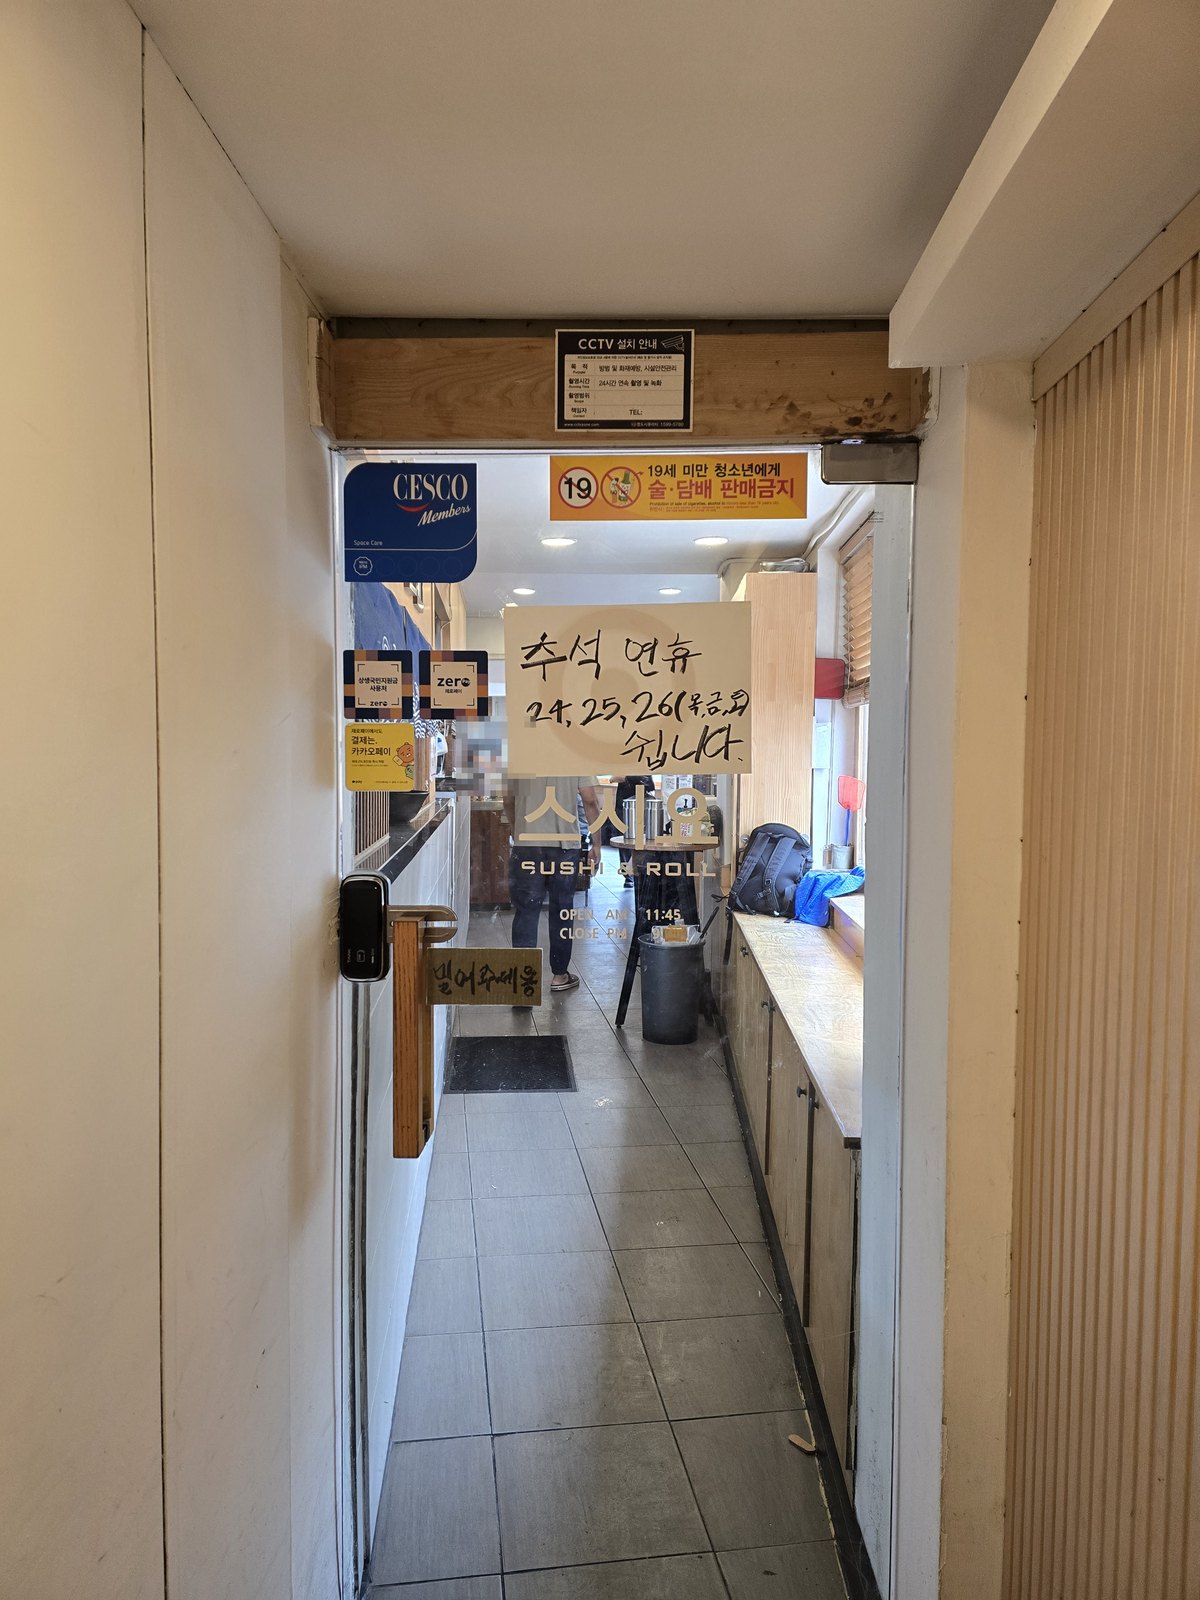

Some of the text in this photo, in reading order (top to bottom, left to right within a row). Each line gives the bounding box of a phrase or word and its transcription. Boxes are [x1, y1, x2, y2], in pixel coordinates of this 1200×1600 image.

[578, 338, 658, 350] CCTV 설치 안내
[599, 379, 617, 387] 24시간
[618, 379, 629, 387] 연속
[630, 379, 642, 387] 촬영
[651, 379, 662, 387] 녹화
[647, 462, 781, 478] 19세 미만 청소년에게
[393, 473, 468, 501] CESCO
[564, 477, 592, 500] 19
[720, 477, 795, 499] 판매금지
[417, 502, 471, 527] Members
[520, 629, 702, 682] 추석 연휴
[351, 747, 391, 756] 카카오페이
[521, 860, 716, 877] SUSHI & ROLL
[559, 908, 681, 921] OPEN AM 11:45
[559, 927, 599, 940] CLOSE
[607, 927, 628, 940] PM
[432, 959, 539, 997] 밀어주세용
